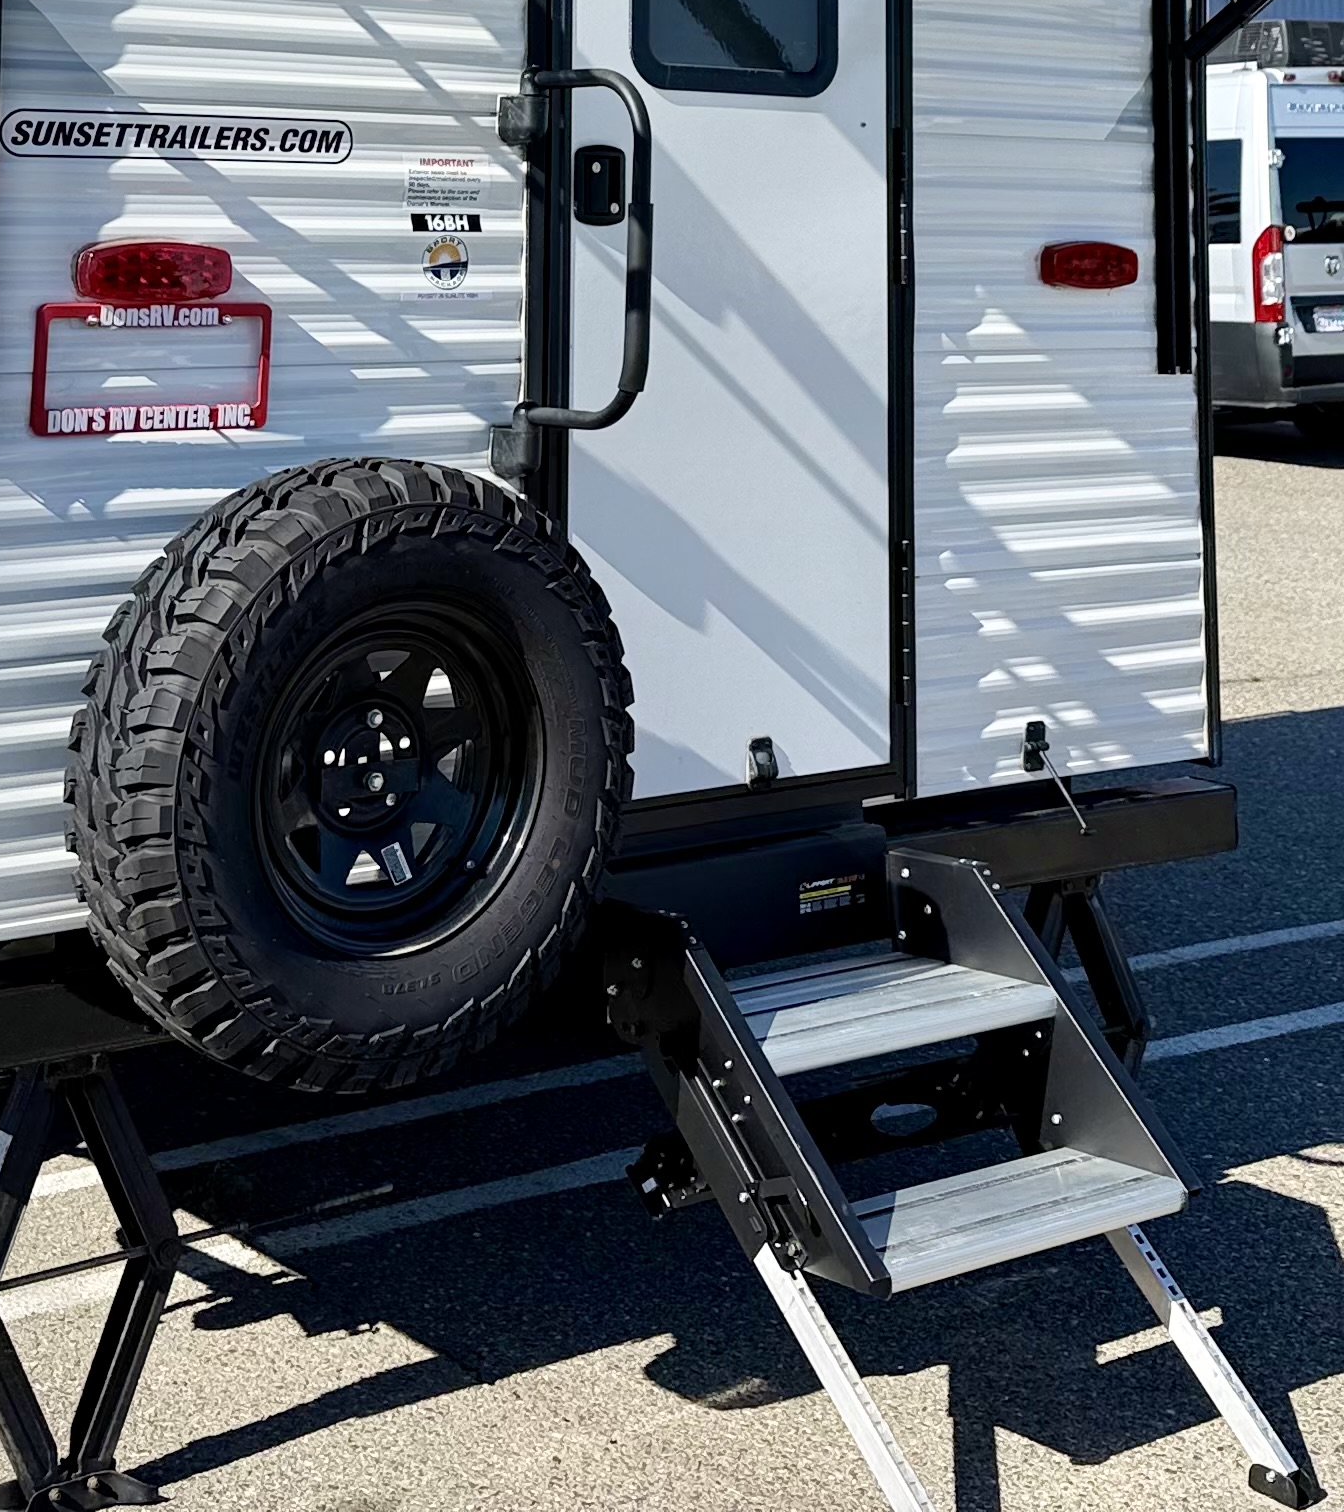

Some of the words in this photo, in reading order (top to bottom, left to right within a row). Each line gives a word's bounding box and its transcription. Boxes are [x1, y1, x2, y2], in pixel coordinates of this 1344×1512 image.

[10, 119, 345, 154] SUNSETTRAILERS.COM
[419, 157, 475, 168] IMPORTANT
[424, 214, 470, 231] 16BH
[99, 303, 220, 328] DonsRV.com
[47, 407, 106, 434] DON'S
[108, 406, 139, 431] RV
[139, 404, 213, 430] CENTER,
[216, 403, 256, 427] INC.
[563, 717, 588, 820] MUD
[451, 836, 571, 985] LEGEND
